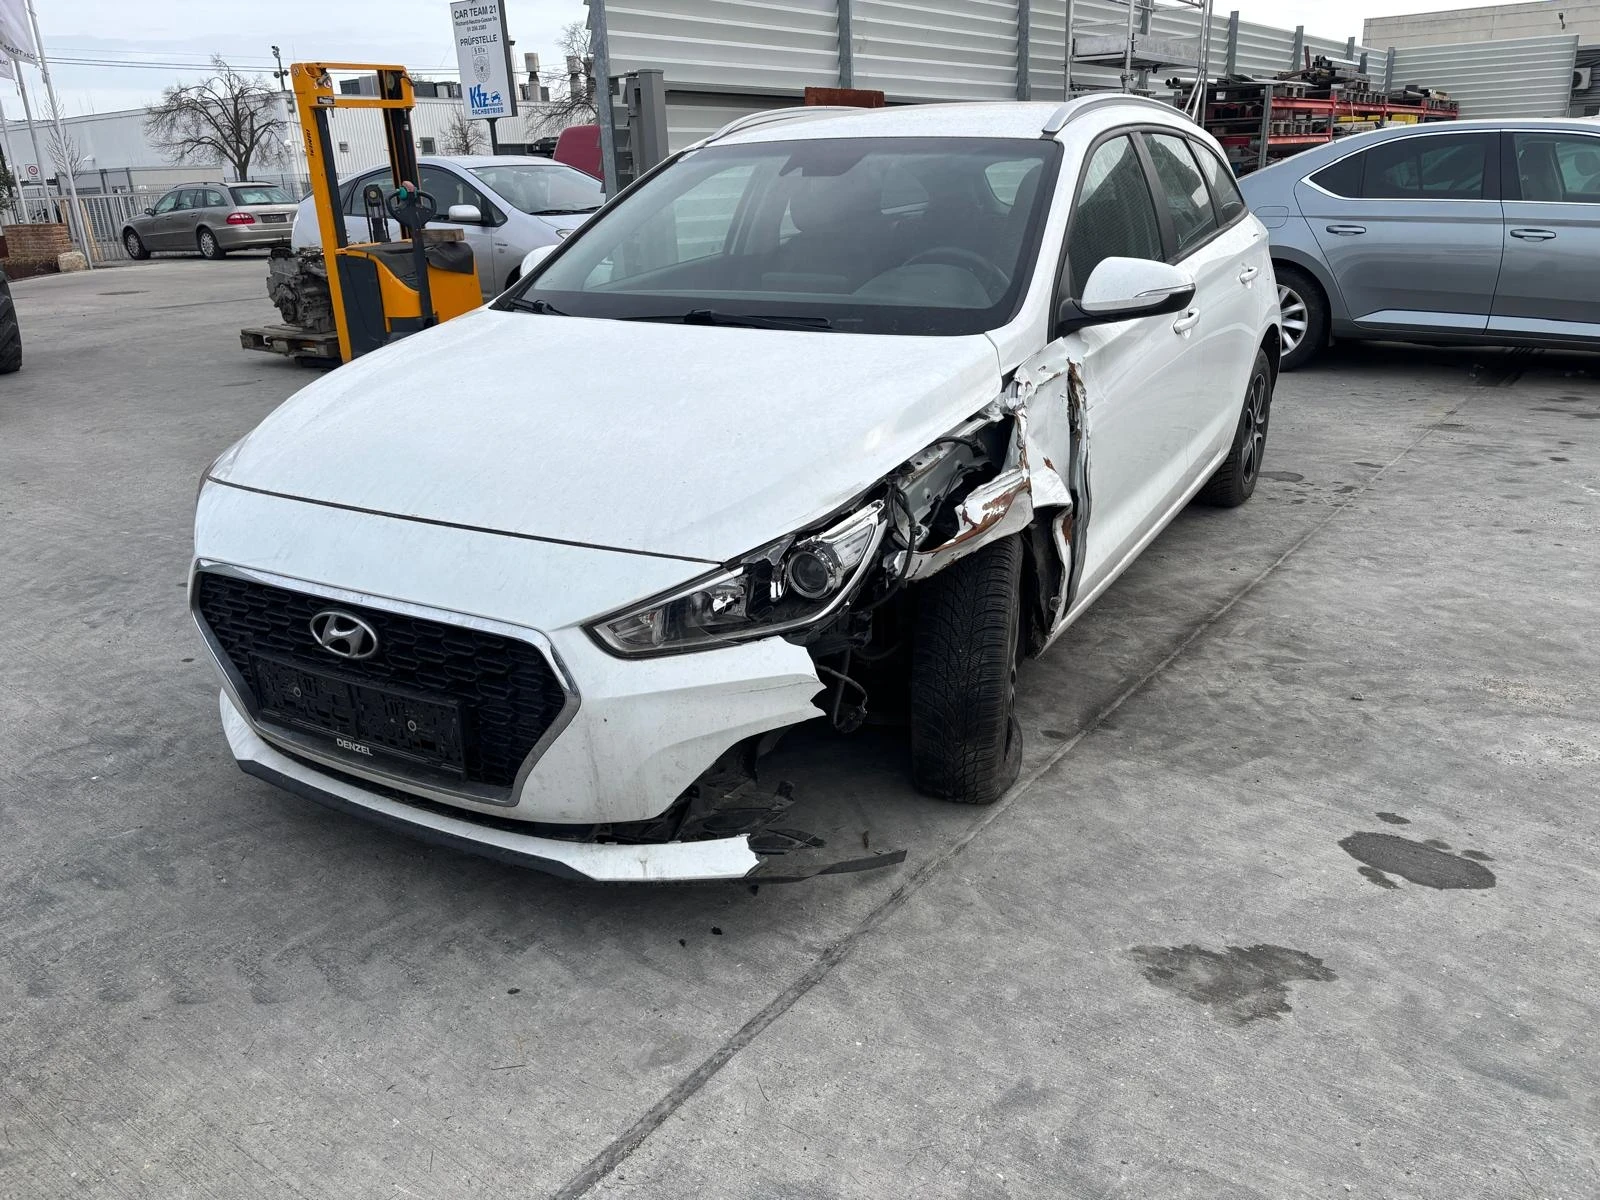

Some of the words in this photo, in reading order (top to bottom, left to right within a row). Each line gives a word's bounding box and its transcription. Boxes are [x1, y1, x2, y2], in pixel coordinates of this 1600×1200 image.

[454, 9, 469, 20] CAR
[469, 6, 488, 17] TEAM
[489, 4, 497, 14] 21
[460, 34, 498, 47] PRÜFSTELLE
[469, 83, 490, 109] Kfz
[472, 107, 504, 116] FACHBETRIEB
[336, 737, 374, 757] DENZEL
